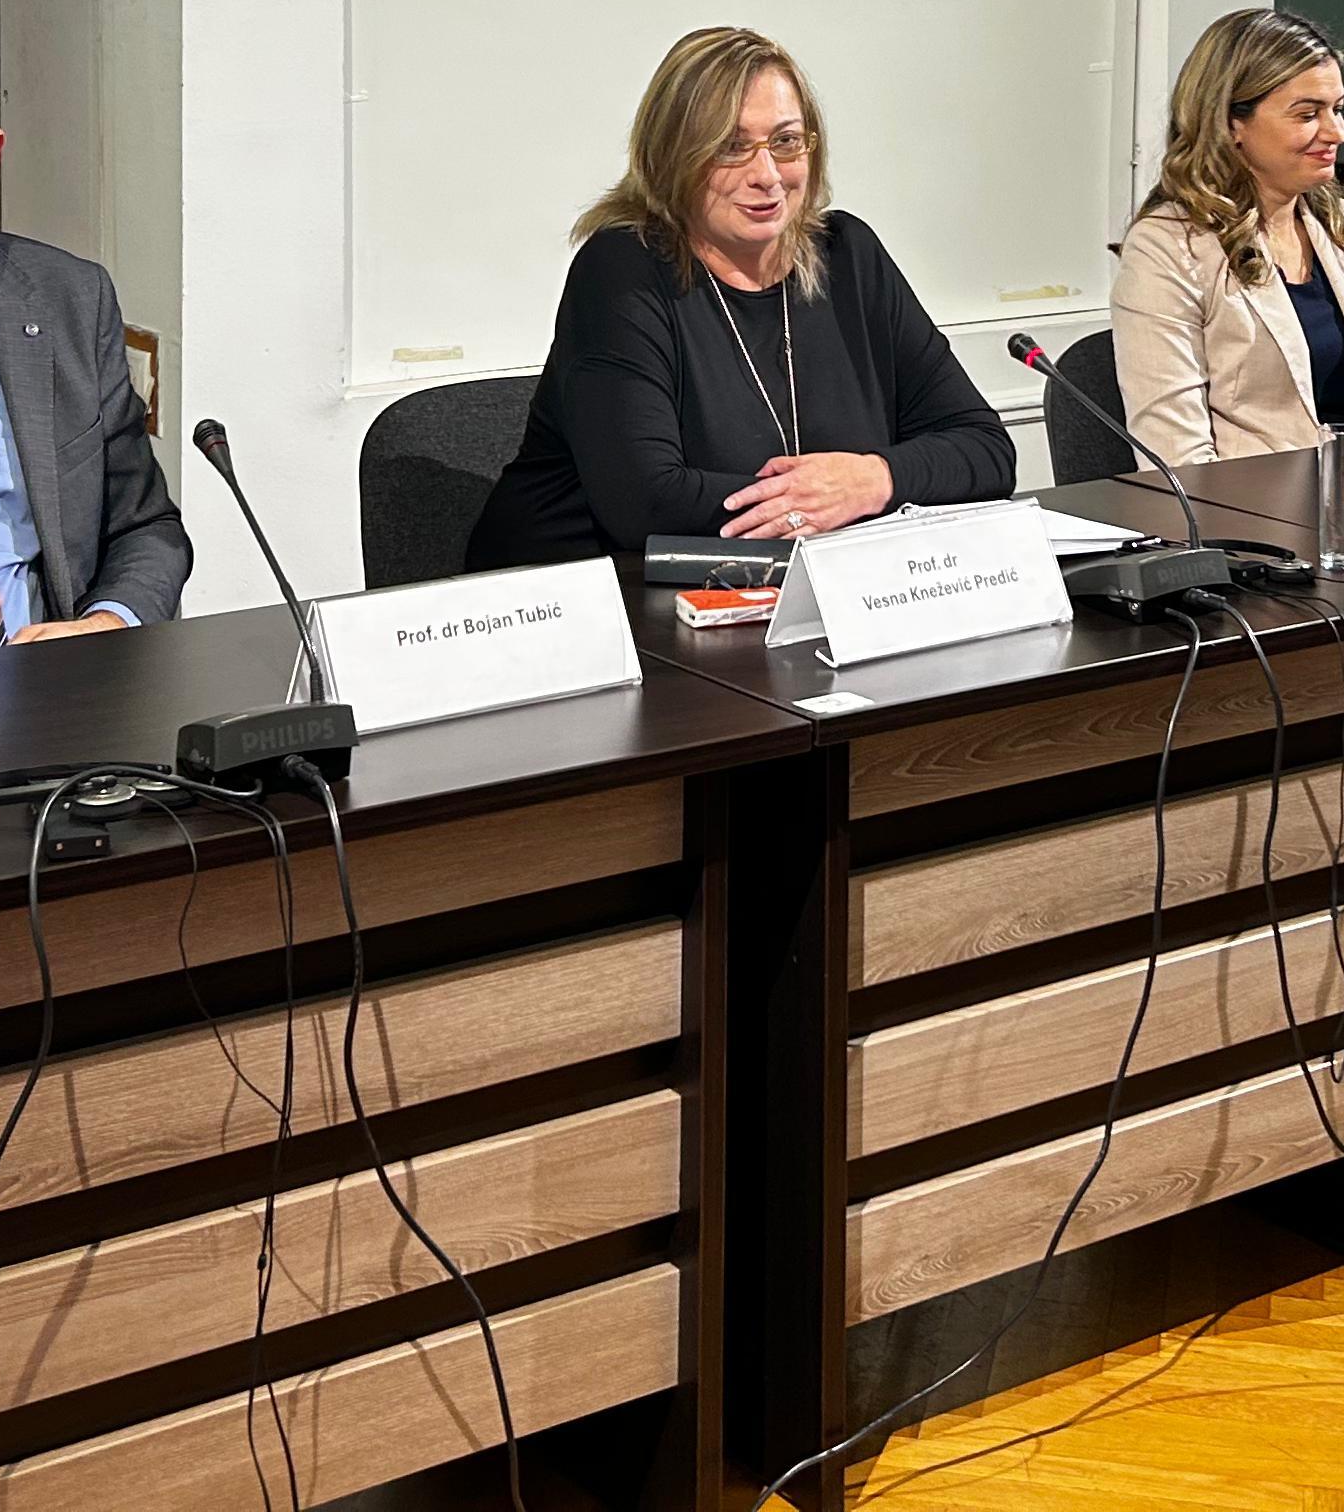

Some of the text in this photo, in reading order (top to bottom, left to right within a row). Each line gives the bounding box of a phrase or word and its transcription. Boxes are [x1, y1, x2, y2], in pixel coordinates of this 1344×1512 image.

[907, 553, 958, 576] Prof. dr
[861, 566, 1020, 611] Vesna Knežević Predić
[396, 602, 563, 647] Prof. dr Bojan Tubić
[241, 717, 336, 754] PHILIPS
